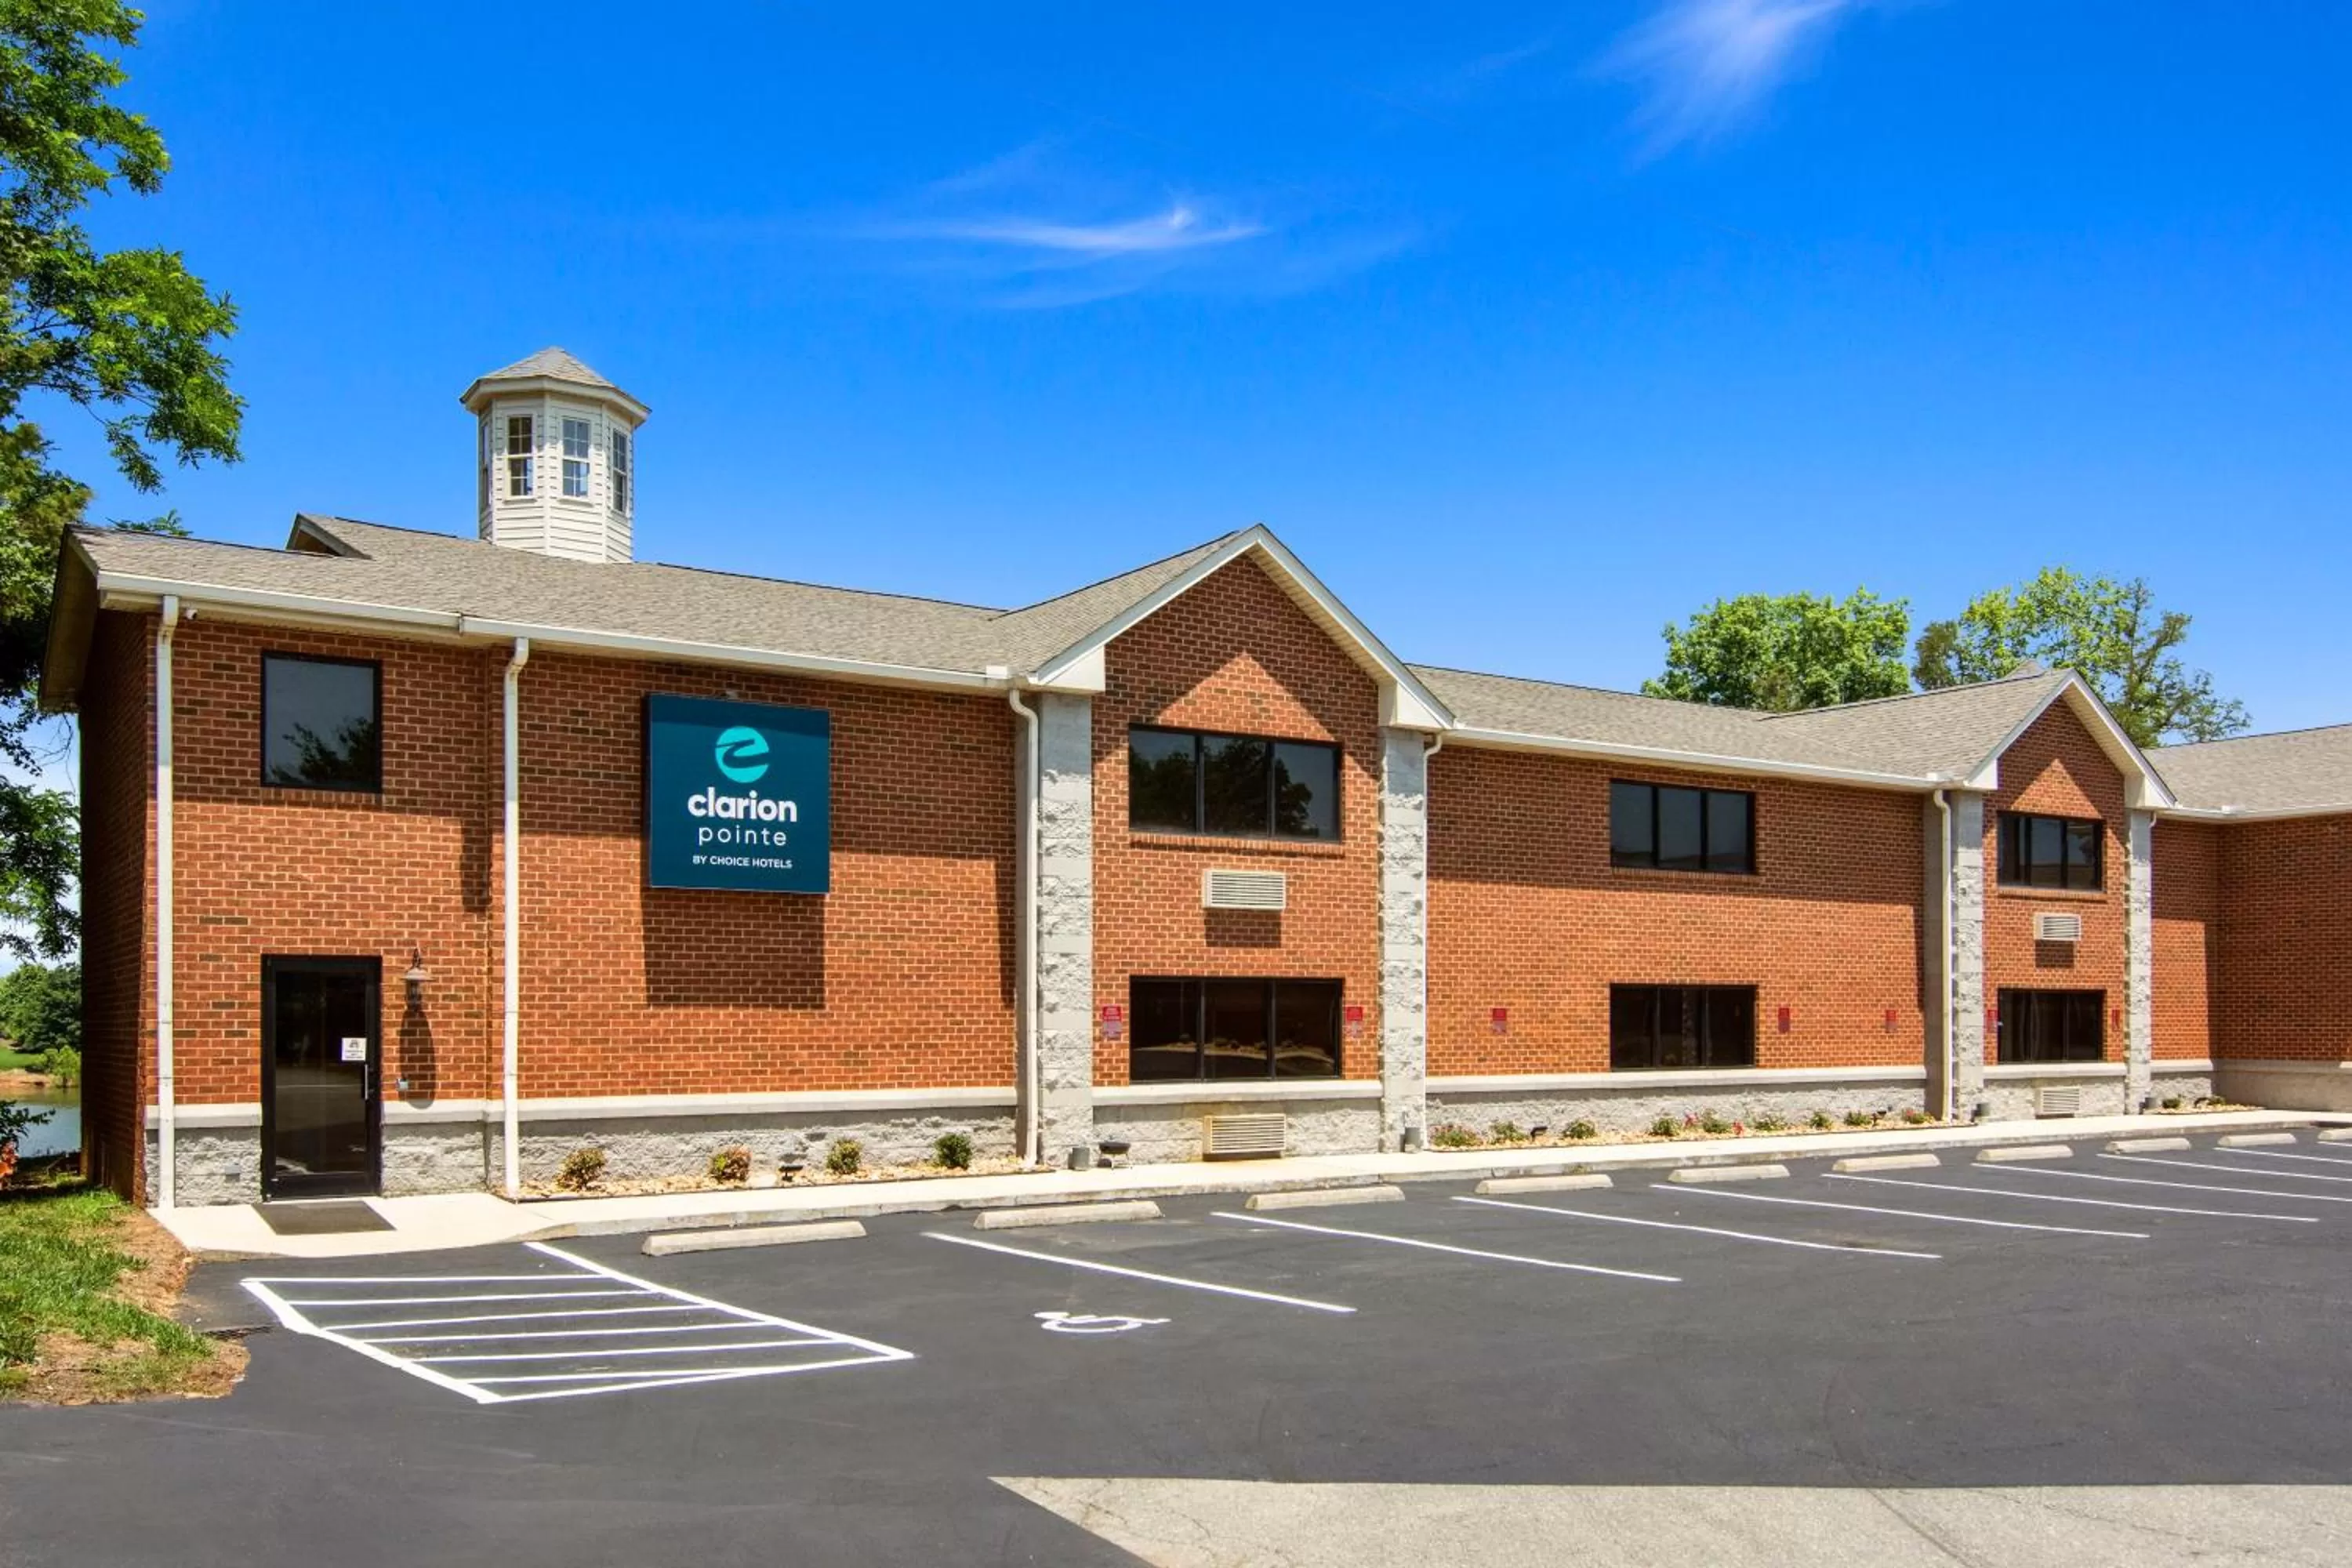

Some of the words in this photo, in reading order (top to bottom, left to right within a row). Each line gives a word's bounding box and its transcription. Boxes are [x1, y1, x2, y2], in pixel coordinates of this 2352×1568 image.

[688, 786, 797, 822] clarion
[699, 825, 786, 846] pointe
[692, 855, 708, 865] BY
[710, 855, 750, 866] CHOICE
[752, 858, 793, 869] HOTELS
